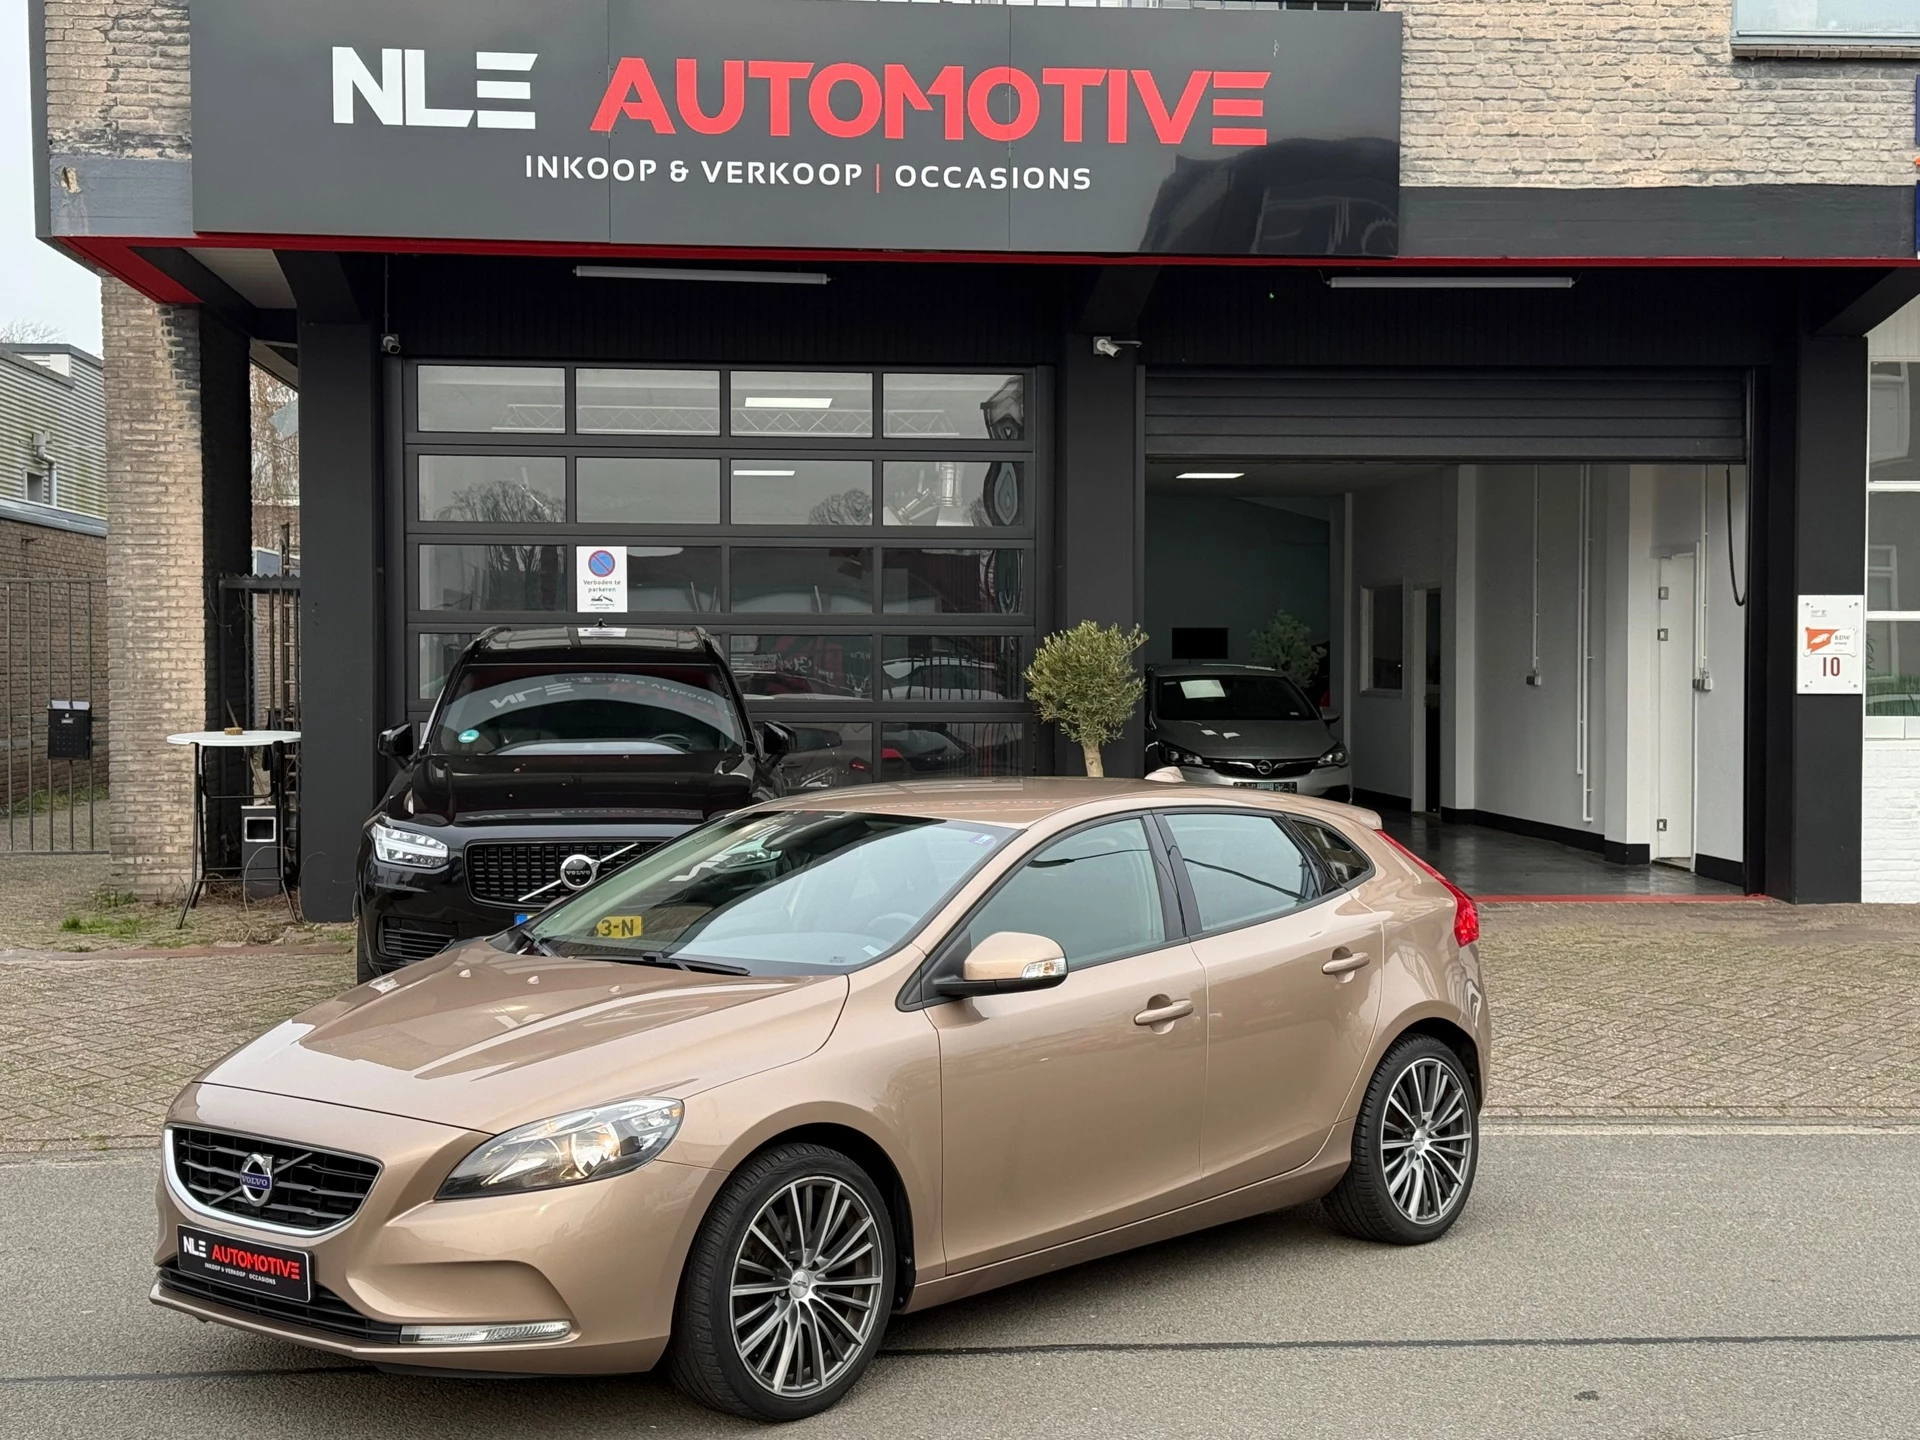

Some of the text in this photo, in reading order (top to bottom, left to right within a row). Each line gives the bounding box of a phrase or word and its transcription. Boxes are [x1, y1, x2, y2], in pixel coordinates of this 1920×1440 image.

[332, 46, 1271, 146] NLE AUTOMOTIVE
[525, 155, 1091, 190] INKOOP & VERKOOP OCCASIONS
[1823, 657, 1840, 677] 10
[241, 1175, 268, 1187] VOLVO
[182, 1235, 301, 1280] NLE AUTOMOTIVE
[204, 1262, 221, 1271] INKOOP
[225, 1268, 246, 1278] VERKOOP
[248, 1274, 276, 1285] OCCASIONS
